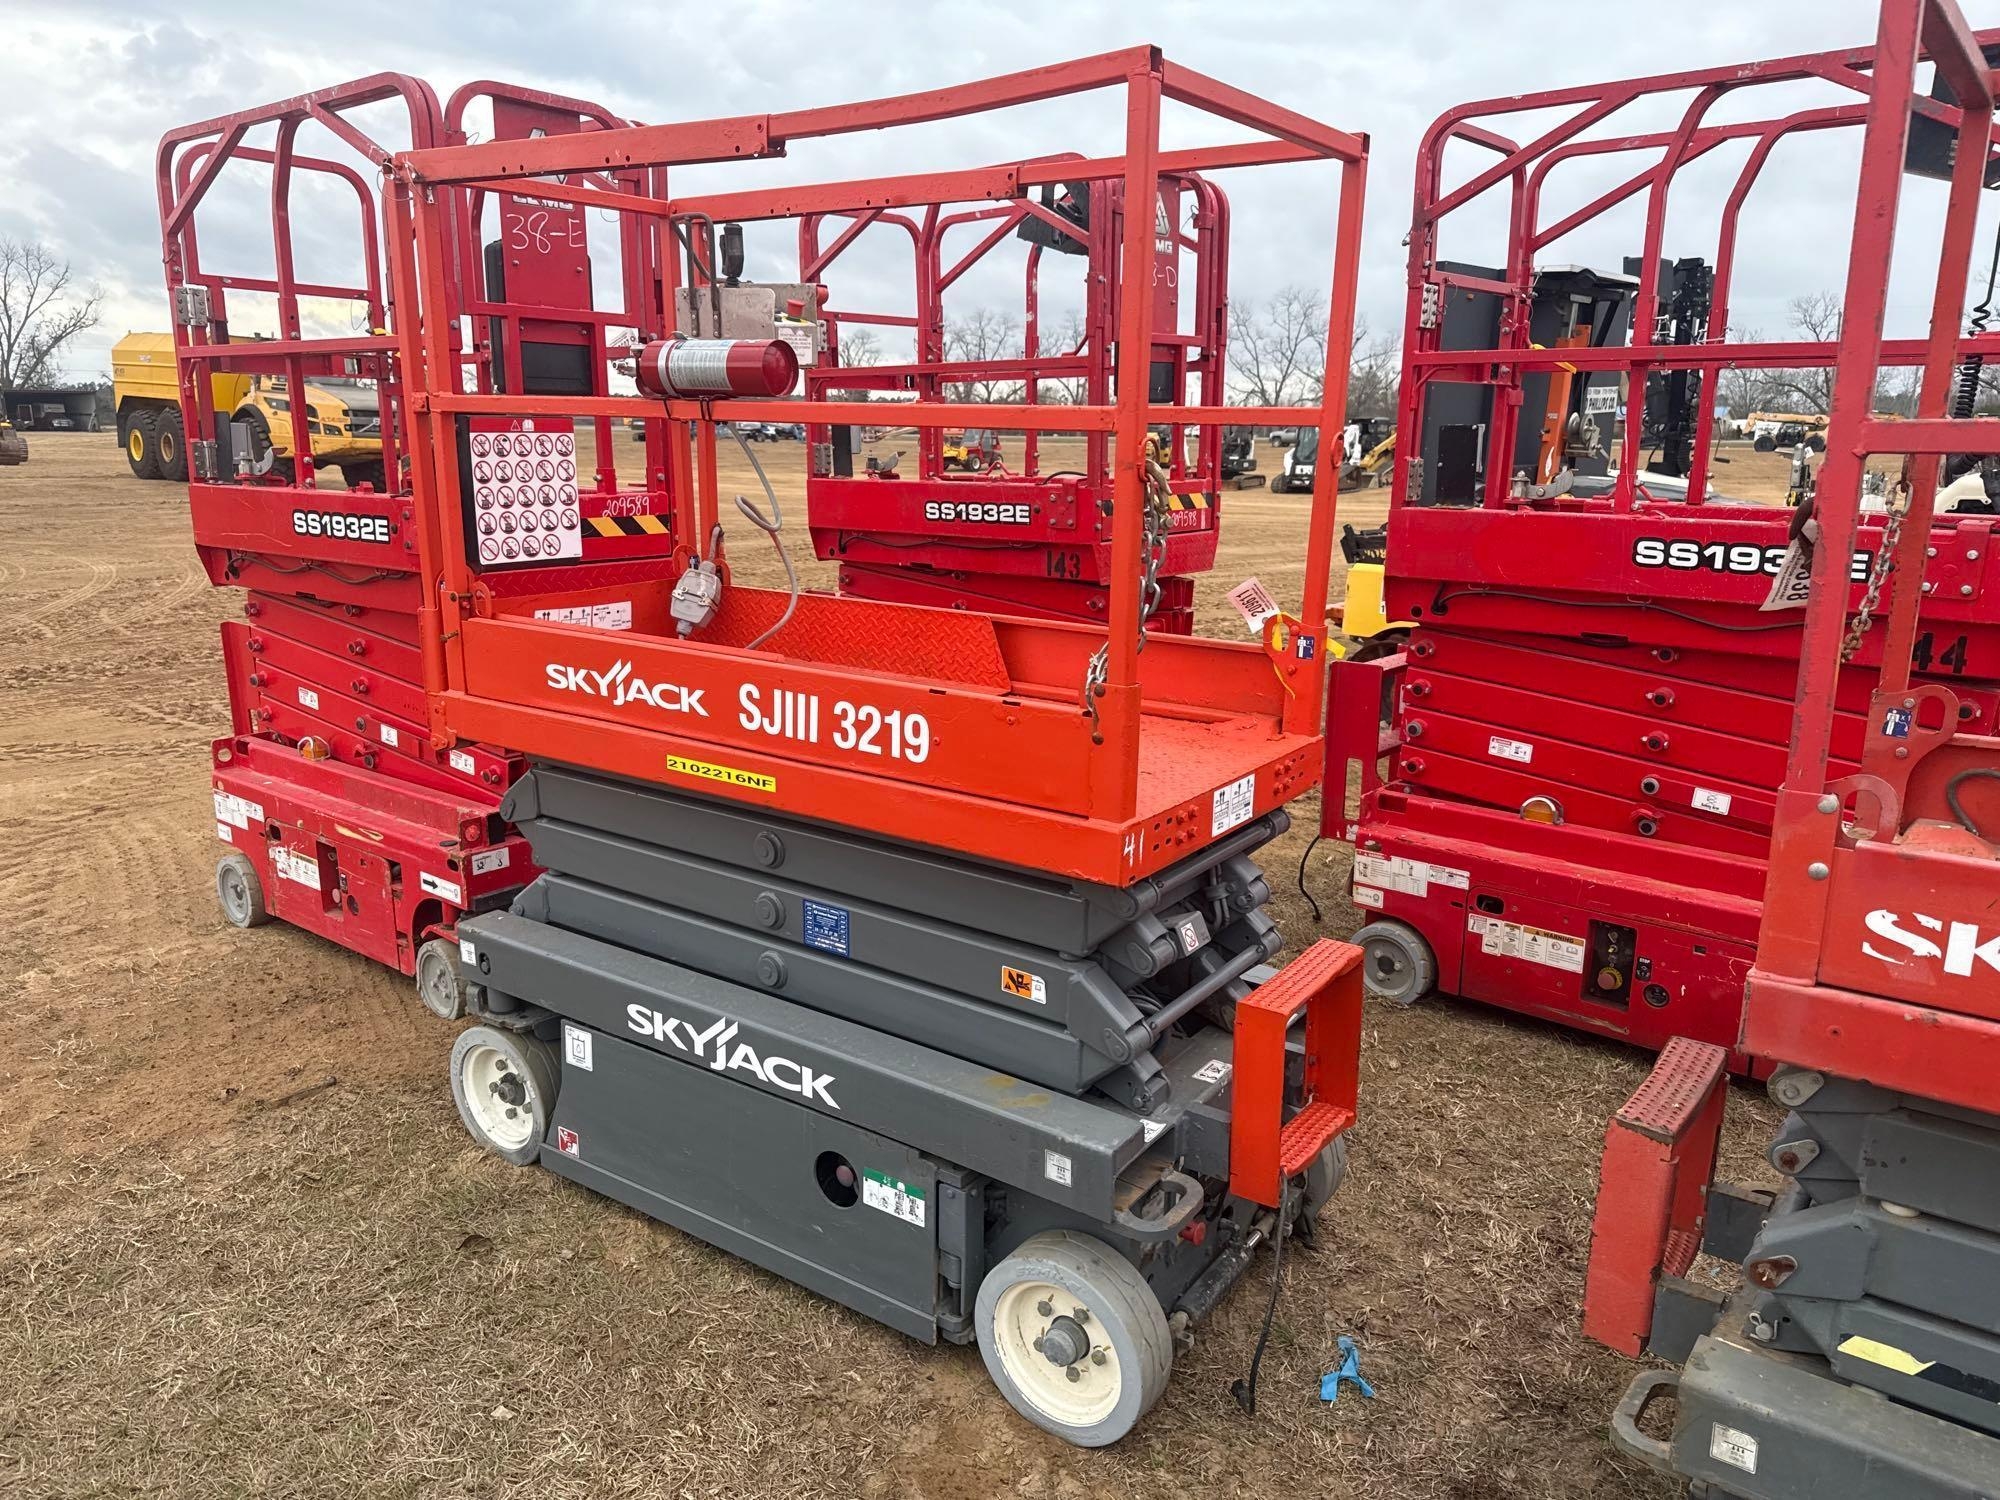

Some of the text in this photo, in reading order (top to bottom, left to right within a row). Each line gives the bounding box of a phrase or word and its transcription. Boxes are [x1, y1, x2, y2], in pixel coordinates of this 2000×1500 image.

[506, 211, 585, 254] 38-E
[602, 495, 650, 517] 209589
[924, 501, 1031, 523] SS1932E
[292, 510, 391, 542] SS1932E
[1046, 549, 1081, 579] 143
[1634, 539, 1869, 581] SS193E
[546, 658, 710, 717] SKYJACK
[738, 682, 931, 764] SJIII 3219
[668, 758, 773, 788] 2102216NF
[1123, 828, 1145, 868] 41
[1543, 930, 1575, 944] WARNING
[626, 1003, 841, 1110] SKYJACK
